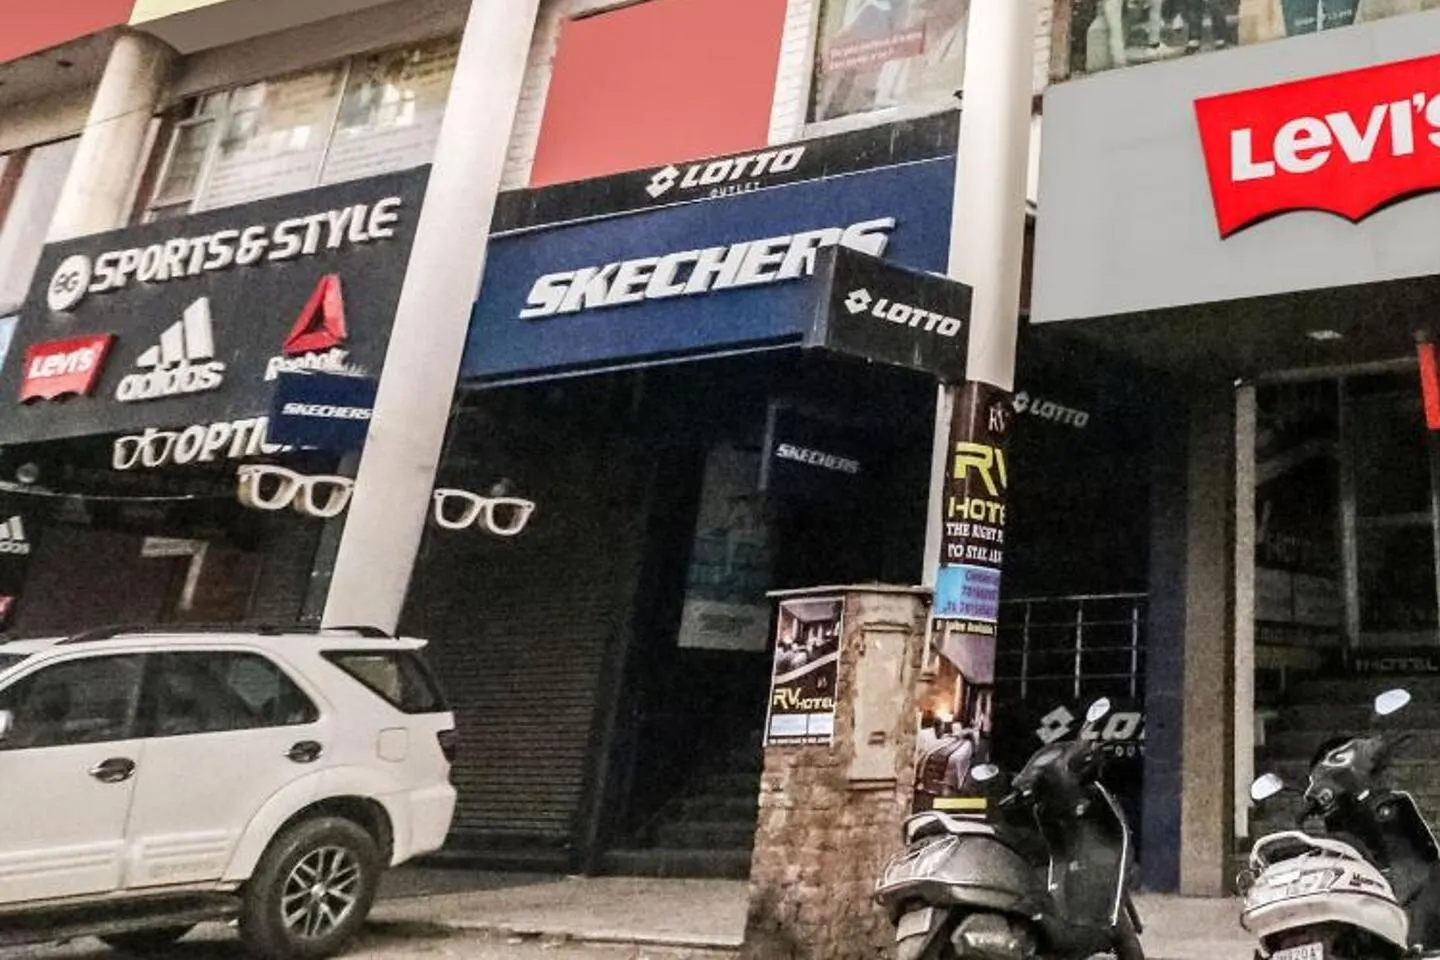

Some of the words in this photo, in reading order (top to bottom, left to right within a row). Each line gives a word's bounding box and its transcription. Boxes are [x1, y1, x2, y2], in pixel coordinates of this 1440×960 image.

[679, 146, 806, 189] LOTTO
[710, 182, 761, 198] OUTLET
[871, 297, 963, 338] LOTTO
[115, 359, 226, 402] adidas
[1029, 397, 1090, 428] LOTTO
